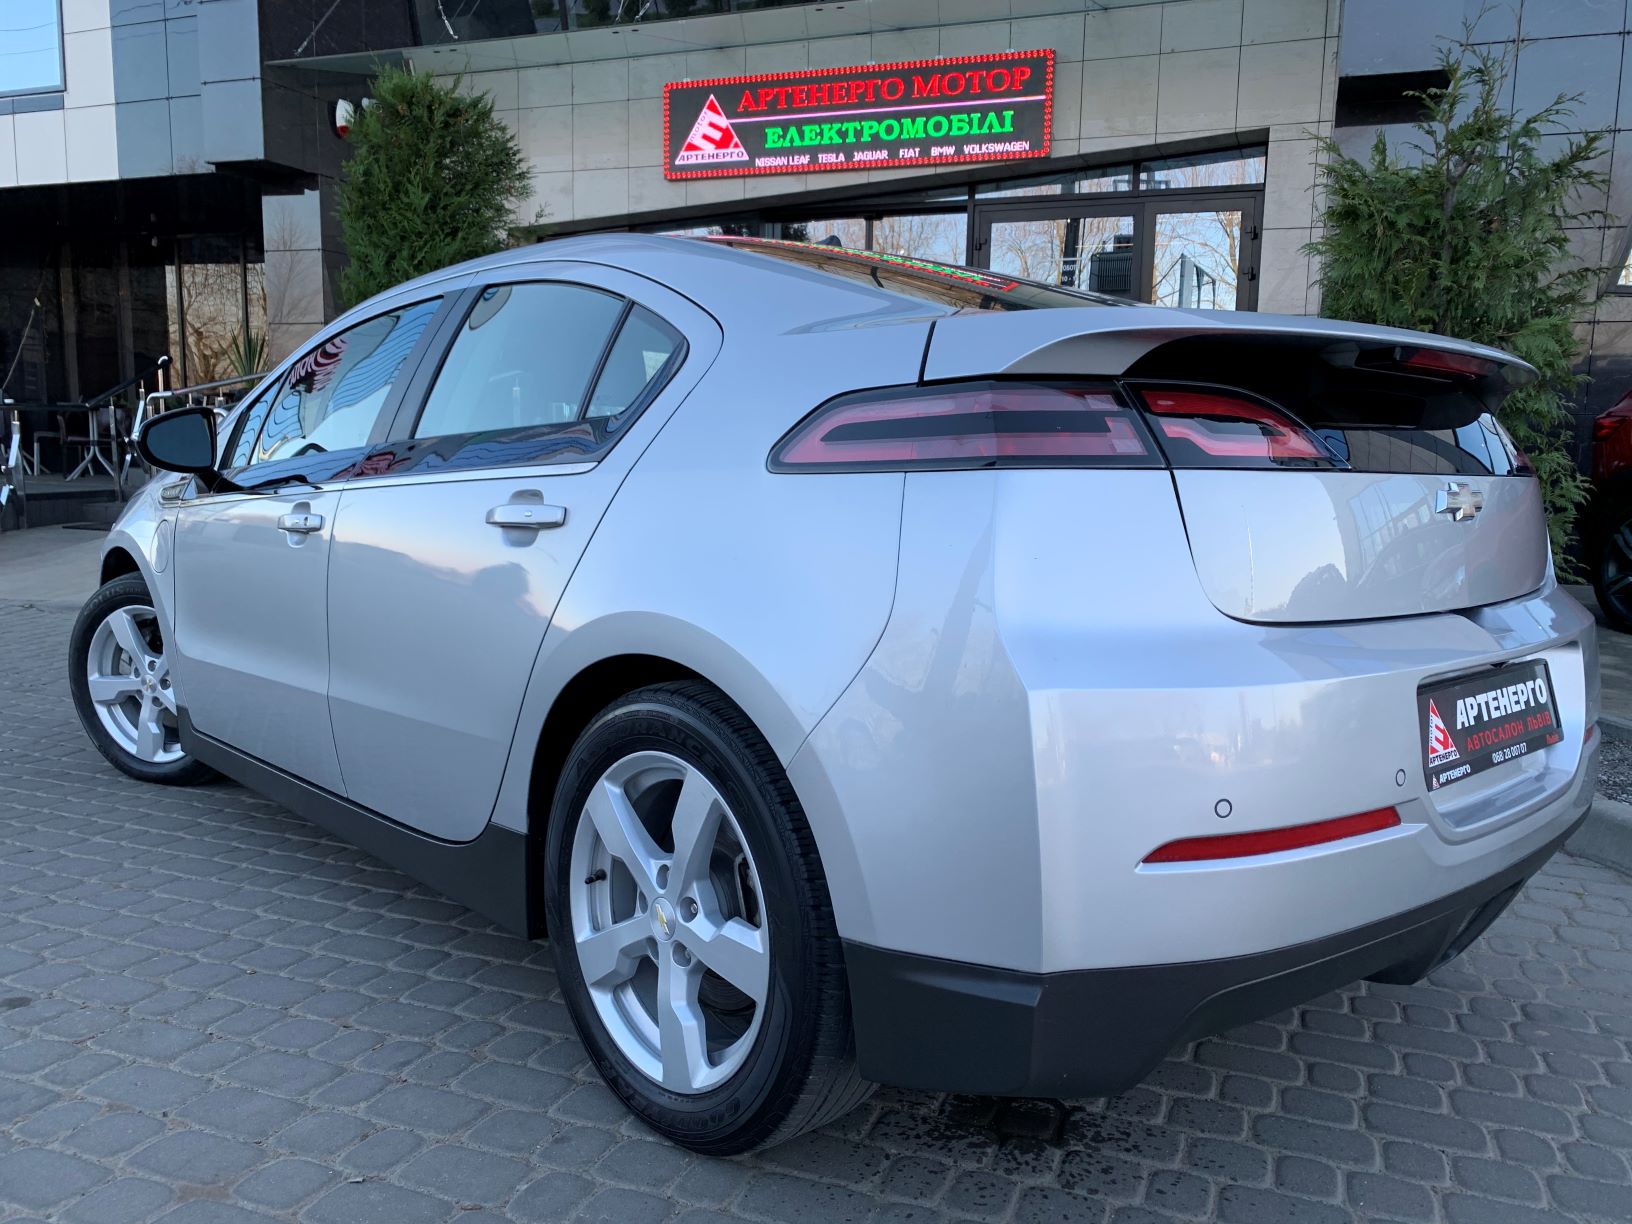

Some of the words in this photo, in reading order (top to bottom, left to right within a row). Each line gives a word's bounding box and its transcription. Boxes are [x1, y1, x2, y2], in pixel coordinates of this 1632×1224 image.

[737, 78, 904, 112] АРТЕНЕРГО
[912, 66, 1032, 99] МОТОР
[765, 110, 1014, 148] ЕЛЕКТРОМОБІЛІ
[678, 150, 744, 162] АРТЕНЕРГО
[755, 156, 788, 167] NISSAN
[789, 154, 811, 166] LEAF
[818, 153, 845, 164] TESLA
[853, 149, 889, 161] JAGUAR
[899, 147, 920, 159] FIAT
[931, 145, 955, 157] BMW
[964, 141, 1030, 154] VOLKSWAGEN
[1457, 678, 1547, 730] АРТЕНЕРГО
[1466, 720, 1525, 752] АВТОСАЛОН
[1429, 749, 1458, 766] АРТЕНЕРГО
[1440, 763, 1471, 784] АРТЕНЕРГО
